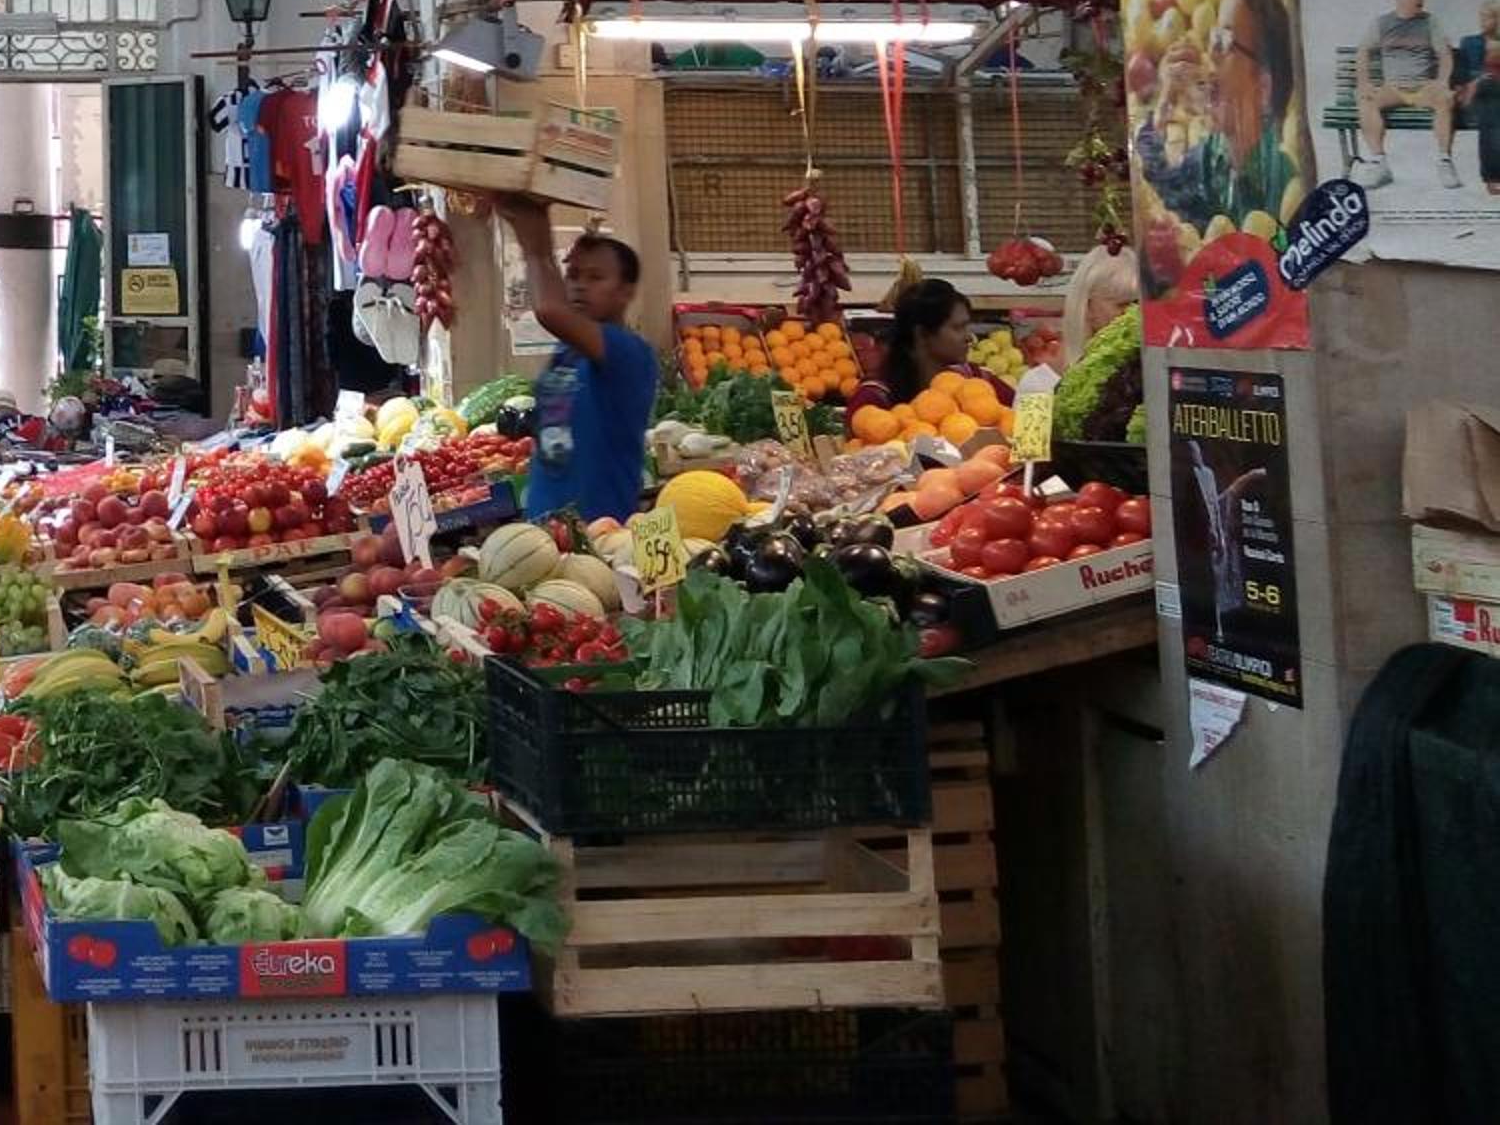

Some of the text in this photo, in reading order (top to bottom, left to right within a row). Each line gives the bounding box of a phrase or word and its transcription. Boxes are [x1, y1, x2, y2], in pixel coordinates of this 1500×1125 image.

[1280, 192, 1364, 280] Melinda
[1173, 402, 1282, 446] ATERBALLETTO
[1245, 579, 1282, 605] 5-6
